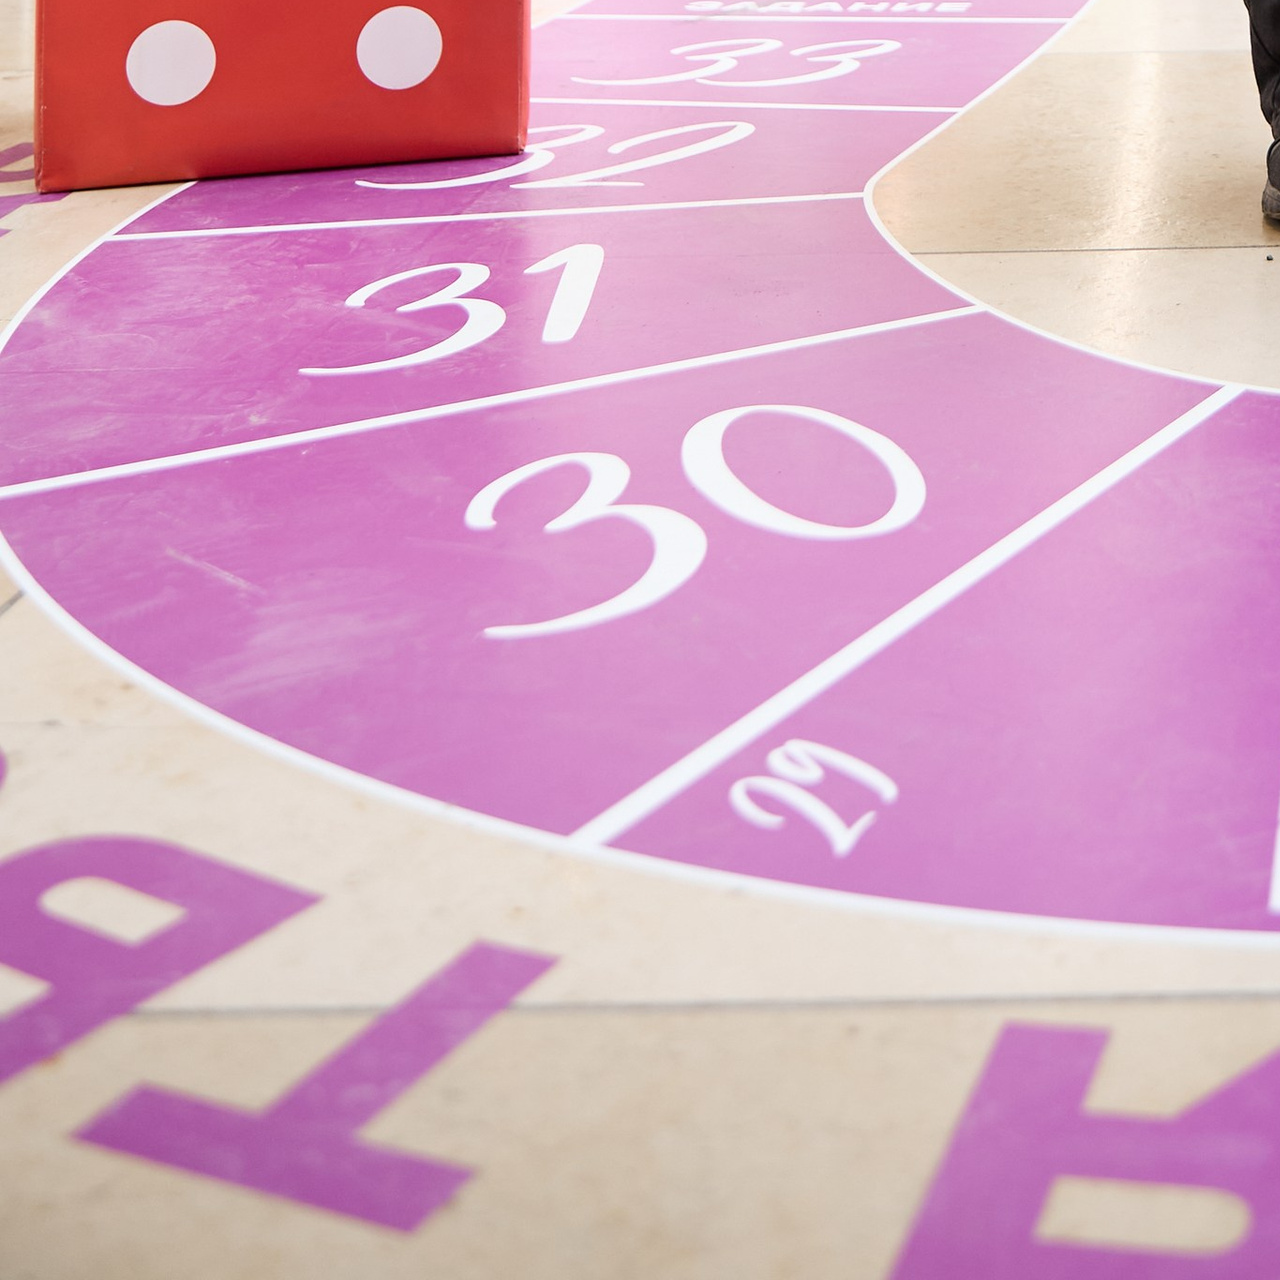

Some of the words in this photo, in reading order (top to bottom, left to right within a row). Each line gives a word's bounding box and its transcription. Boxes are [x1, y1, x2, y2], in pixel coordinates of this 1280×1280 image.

[685, 0, 973, 13] ЗАДАНИЕ
[570, 37, 902, 88] 33
[355, 121, 756, 190] 32
[298, 243, 605, 375] 31
[464, 403, 927, 639] 30
[728, 737, 900, 858] 29
